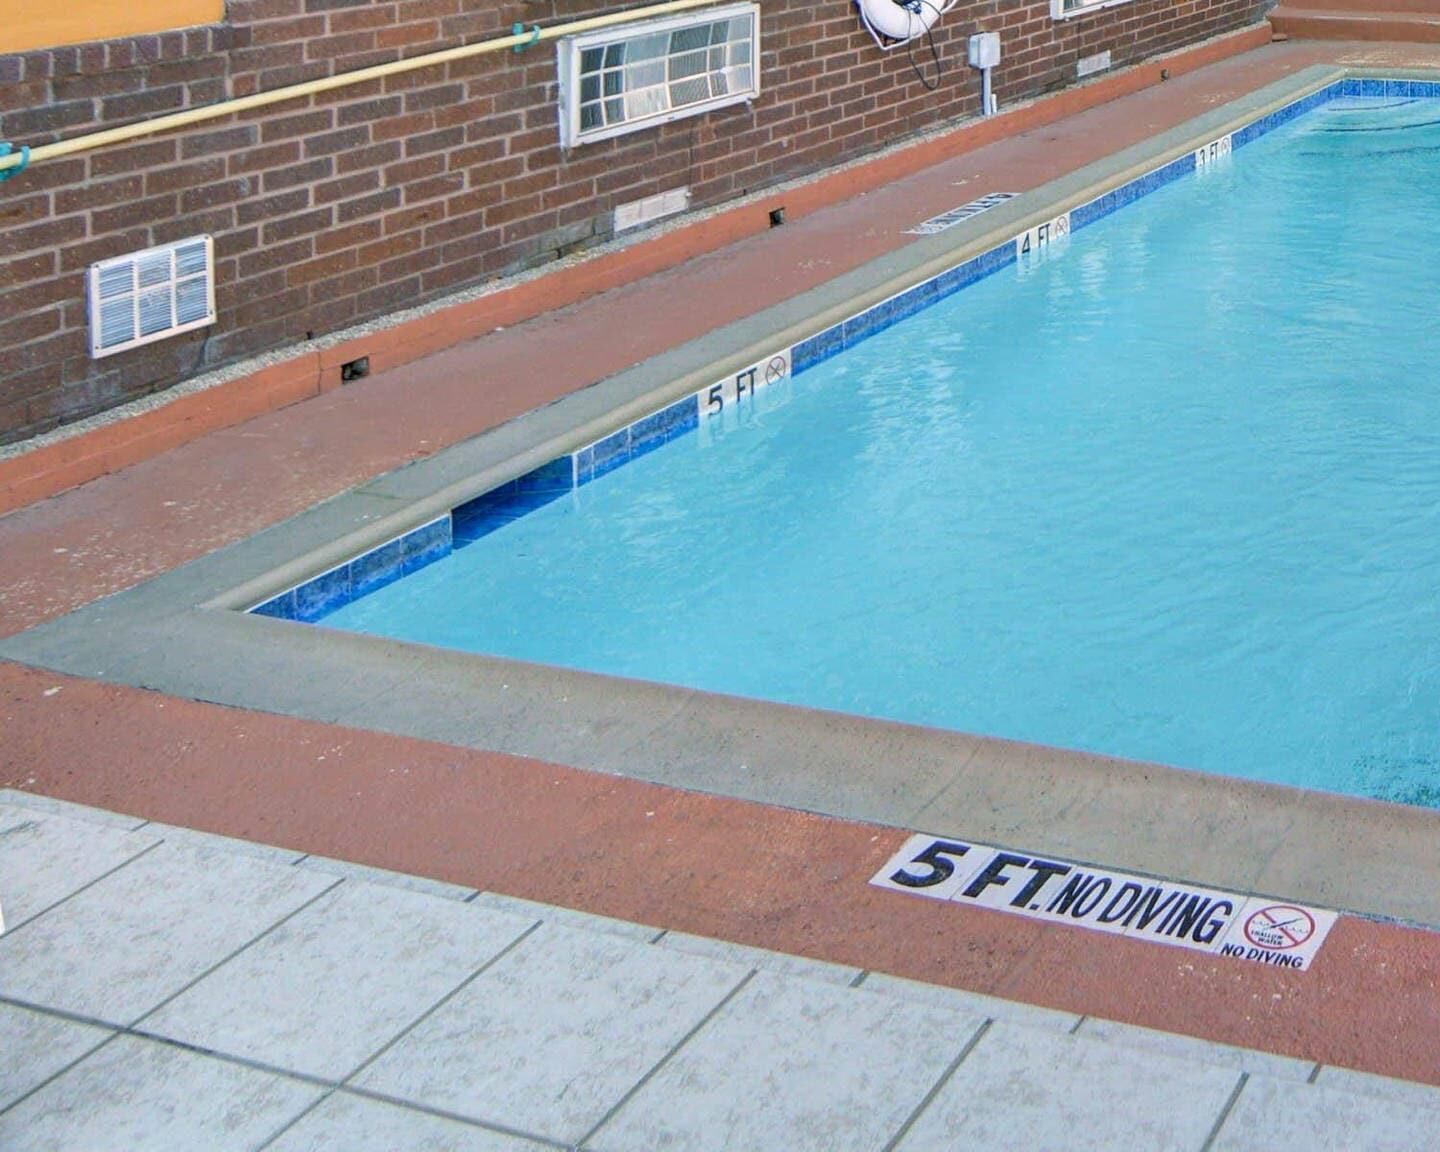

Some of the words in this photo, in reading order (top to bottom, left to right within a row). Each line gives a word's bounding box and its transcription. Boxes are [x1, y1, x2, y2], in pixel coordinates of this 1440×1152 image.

[1210, 142, 1219, 161] FT
[1021, 231, 1031, 254] 4
[1038, 223, 1051, 249] FT
[708, 384, 724, 417] 5
[736, 367, 758, 404] FT
[889, 839, 972, 888] 5
[1046, 872, 1113, 919] NO
[1096, 881, 1233, 945] DIVING
[1220, 942, 1246, 957] NO
[1246, 947, 1304, 968] DIVING
